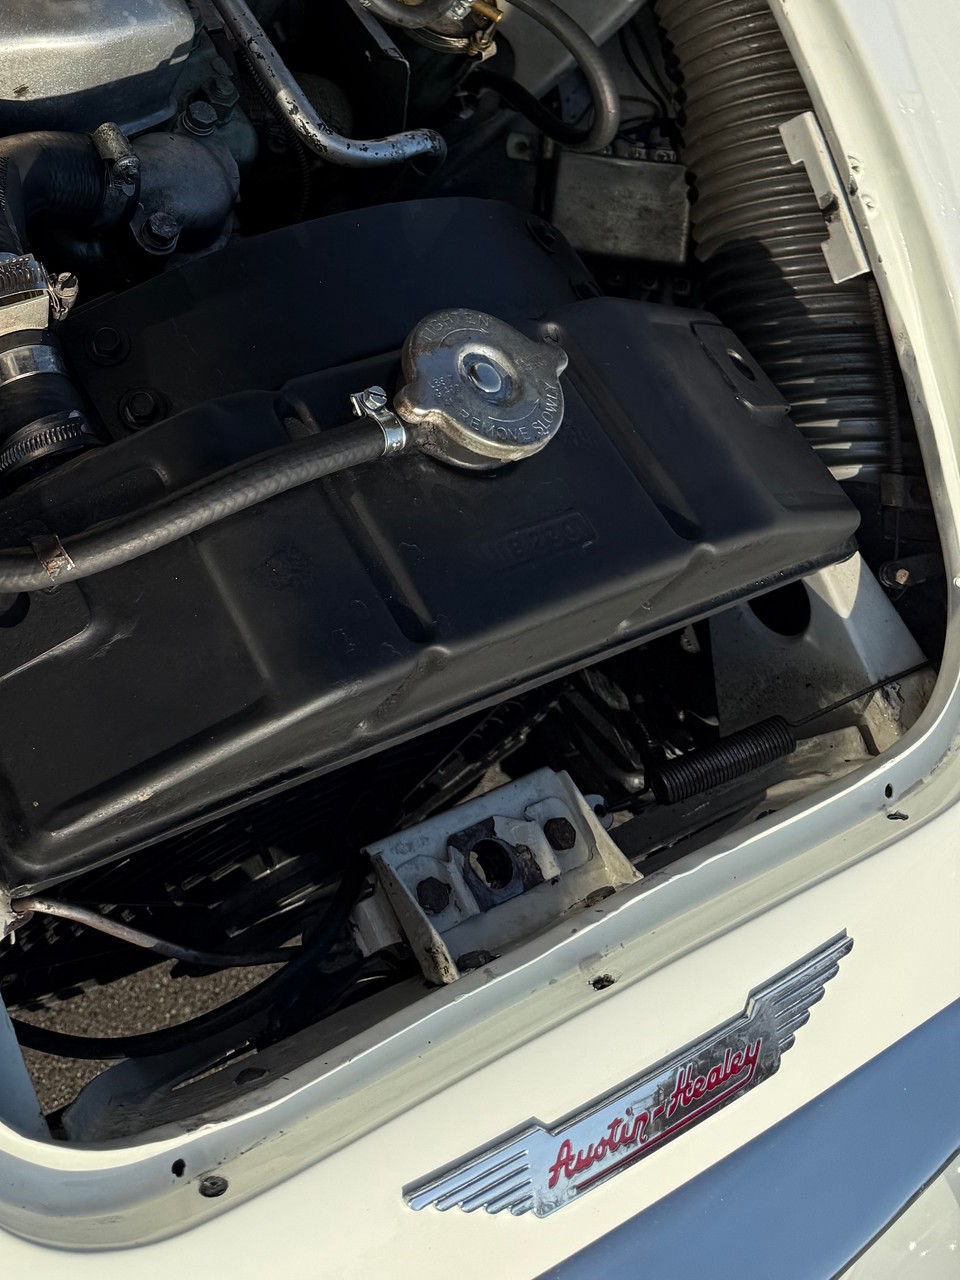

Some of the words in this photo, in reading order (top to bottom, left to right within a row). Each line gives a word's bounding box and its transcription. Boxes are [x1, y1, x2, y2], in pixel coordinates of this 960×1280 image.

[421, 309, 491, 342] TIGHTEN
[459, 408, 532, 441] REMOVE
[531, 381, 558, 436] SLOWLY
[548, 1037, 763, 1190] Austin-Healey
